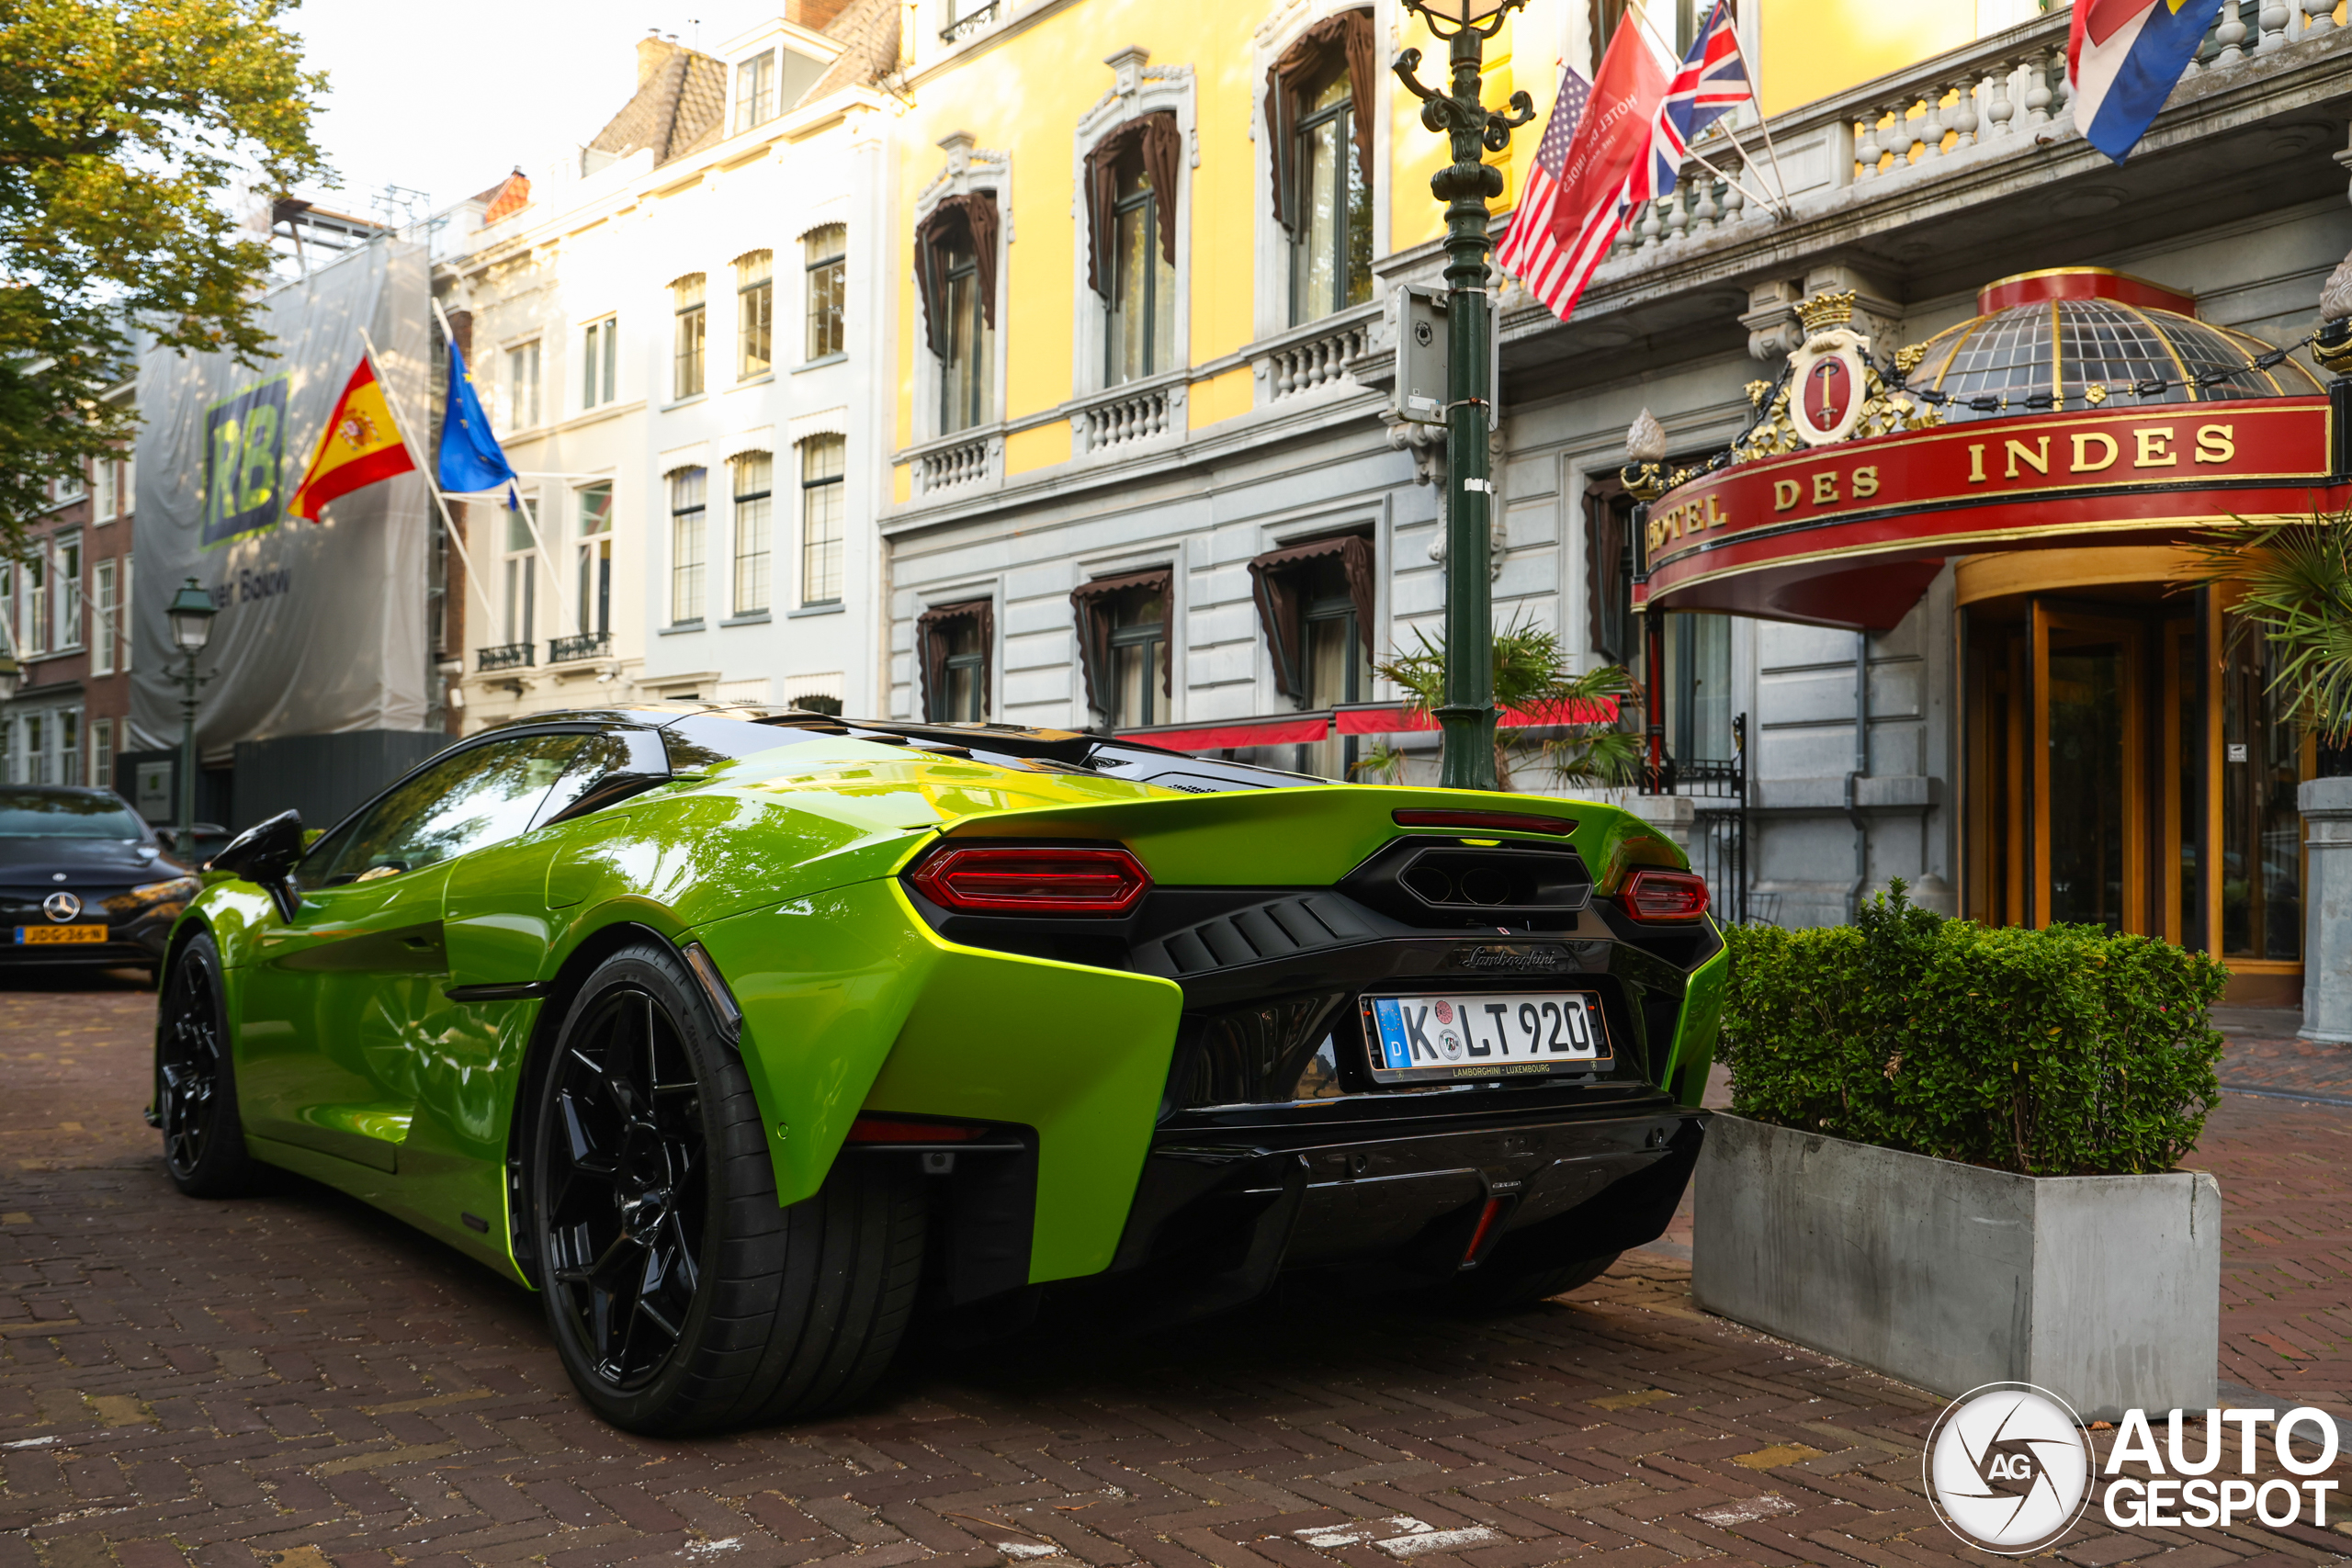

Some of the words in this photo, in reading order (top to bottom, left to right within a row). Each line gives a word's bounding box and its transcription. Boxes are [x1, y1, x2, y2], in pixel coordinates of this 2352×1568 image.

[209, 403, 278, 526] RB
[1649, 493, 1728, 552] HOTEL
[1773, 465, 1880, 511] DES
[1968, 423, 2235, 483] INDES
[1459, 945, 1556, 971] Lamborghini
[1390, 1041, 1403, 1057] D
[1403, 1005, 1440, 1060] K
[1458, 1003, 1510, 1056] LT
[1518, 1000, 1590, 1055] 920
[1452, 1066, 1501, 1077] LAMBORGHINI
[1505, 1064, 1551, 1075] LUXEMBOURG
